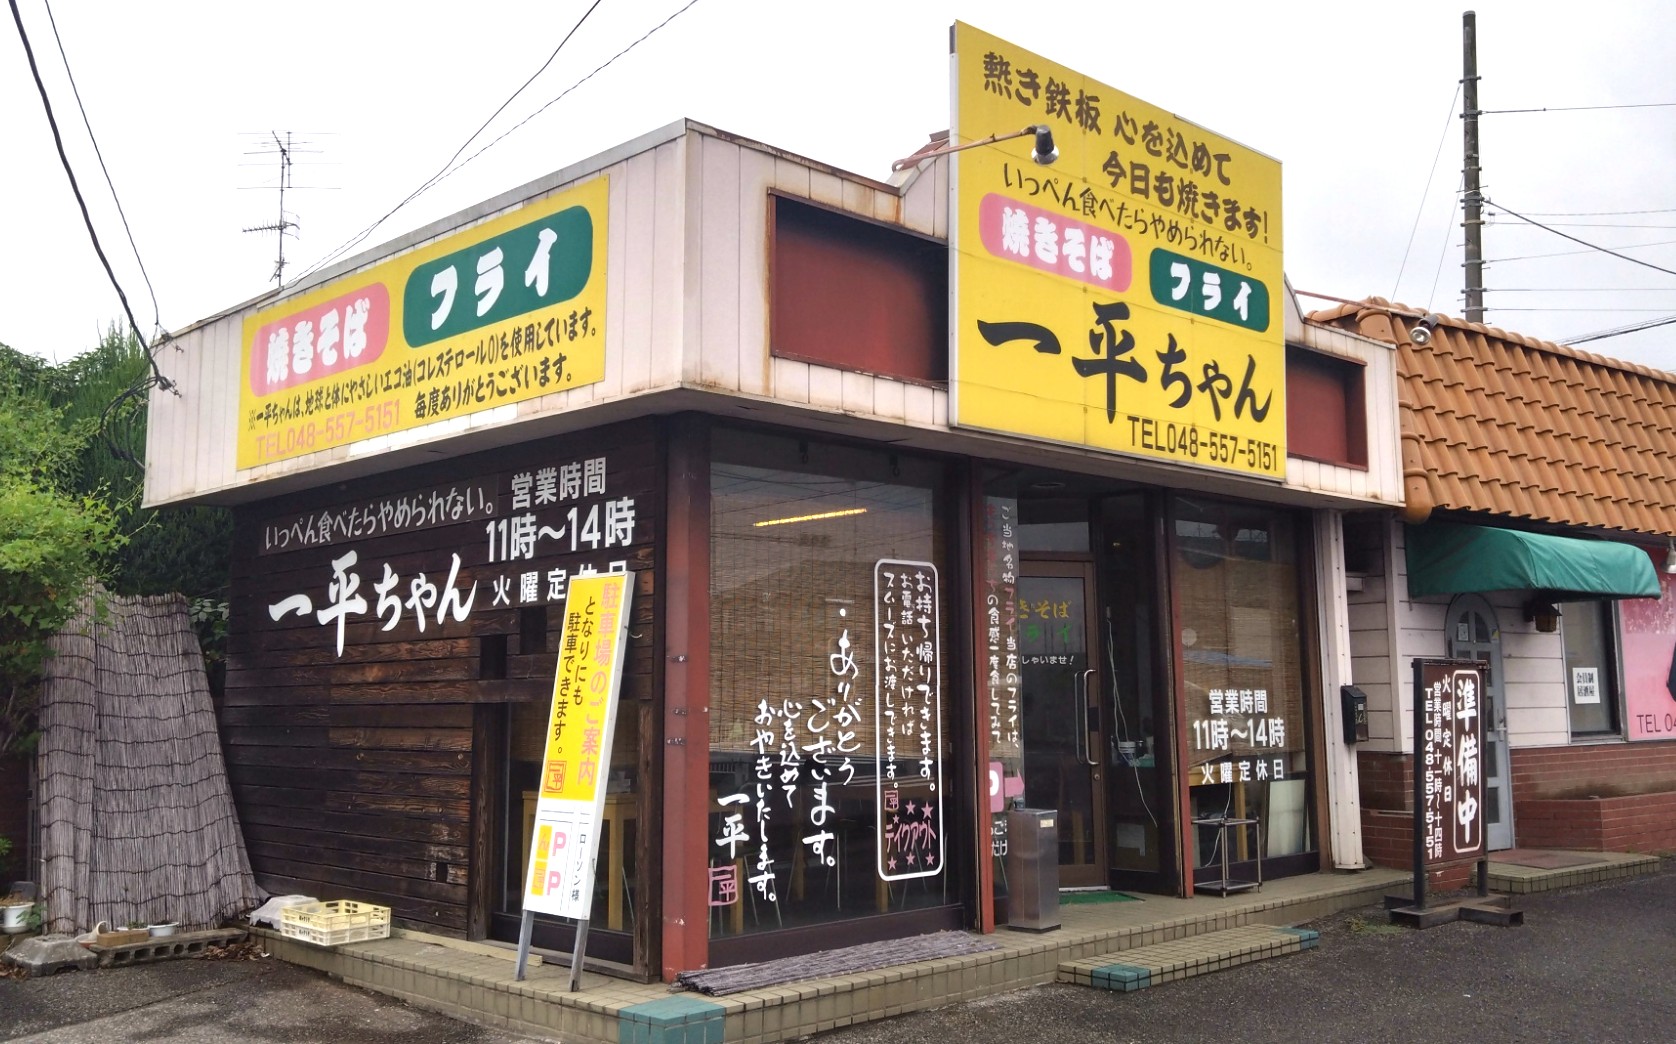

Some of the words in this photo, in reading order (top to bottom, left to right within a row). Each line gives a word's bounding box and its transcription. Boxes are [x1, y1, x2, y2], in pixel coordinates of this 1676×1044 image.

[983, 51, 1102, 135] 熱き鉄板
[1114, 111, 1232, 186] 心を込めて
[1001, 206, 1115, 281] 焼きそば
[1004, 163, 1253, 272] いっぺん食べたらやめられない。
[430, 227, 558, 331] フライ
[1170, 261, 1252, 321] フライ
[266, 297, 371, 385] 焼きそば
[415, 353, 572, 420] 毎度ありがとうございます。
[977, 301, 1273, 424] 一平ちゃん
[265, 487, 494, 550] いっぺん食べたらやめられない。
[511, 457, 607, 510] 営業時間
[269, 550, 478, 658] 一平ちゃん
[572, 596, 596, 706] となりにも
[554, 612, 581, 755] 駐車できます。
[576, 582, 620, 787] 駐車場のご案内
[883, 572, 899, 789] スムーズにお渡しできます。
[915, 571, 936, 792] お持ち帰りできます。
[1208, 689, 1268, 715] 営業時間
[1636, 714, 1661, 733] TEL
[777, 698, 803, 809] 心を込めて
[802, 699, 836, 868] ございます。
[1200, 759, 1284, 785] 火曜定休日
[1442, 674, 1453, 803] 火曜定休日
[1456, 678, 1478, 844] 準備中
[715, 793, 751, 860] 一平
[748, 699, 777, 902] おやきいたします。
[884, 819, 936, 853] テイクアウト
